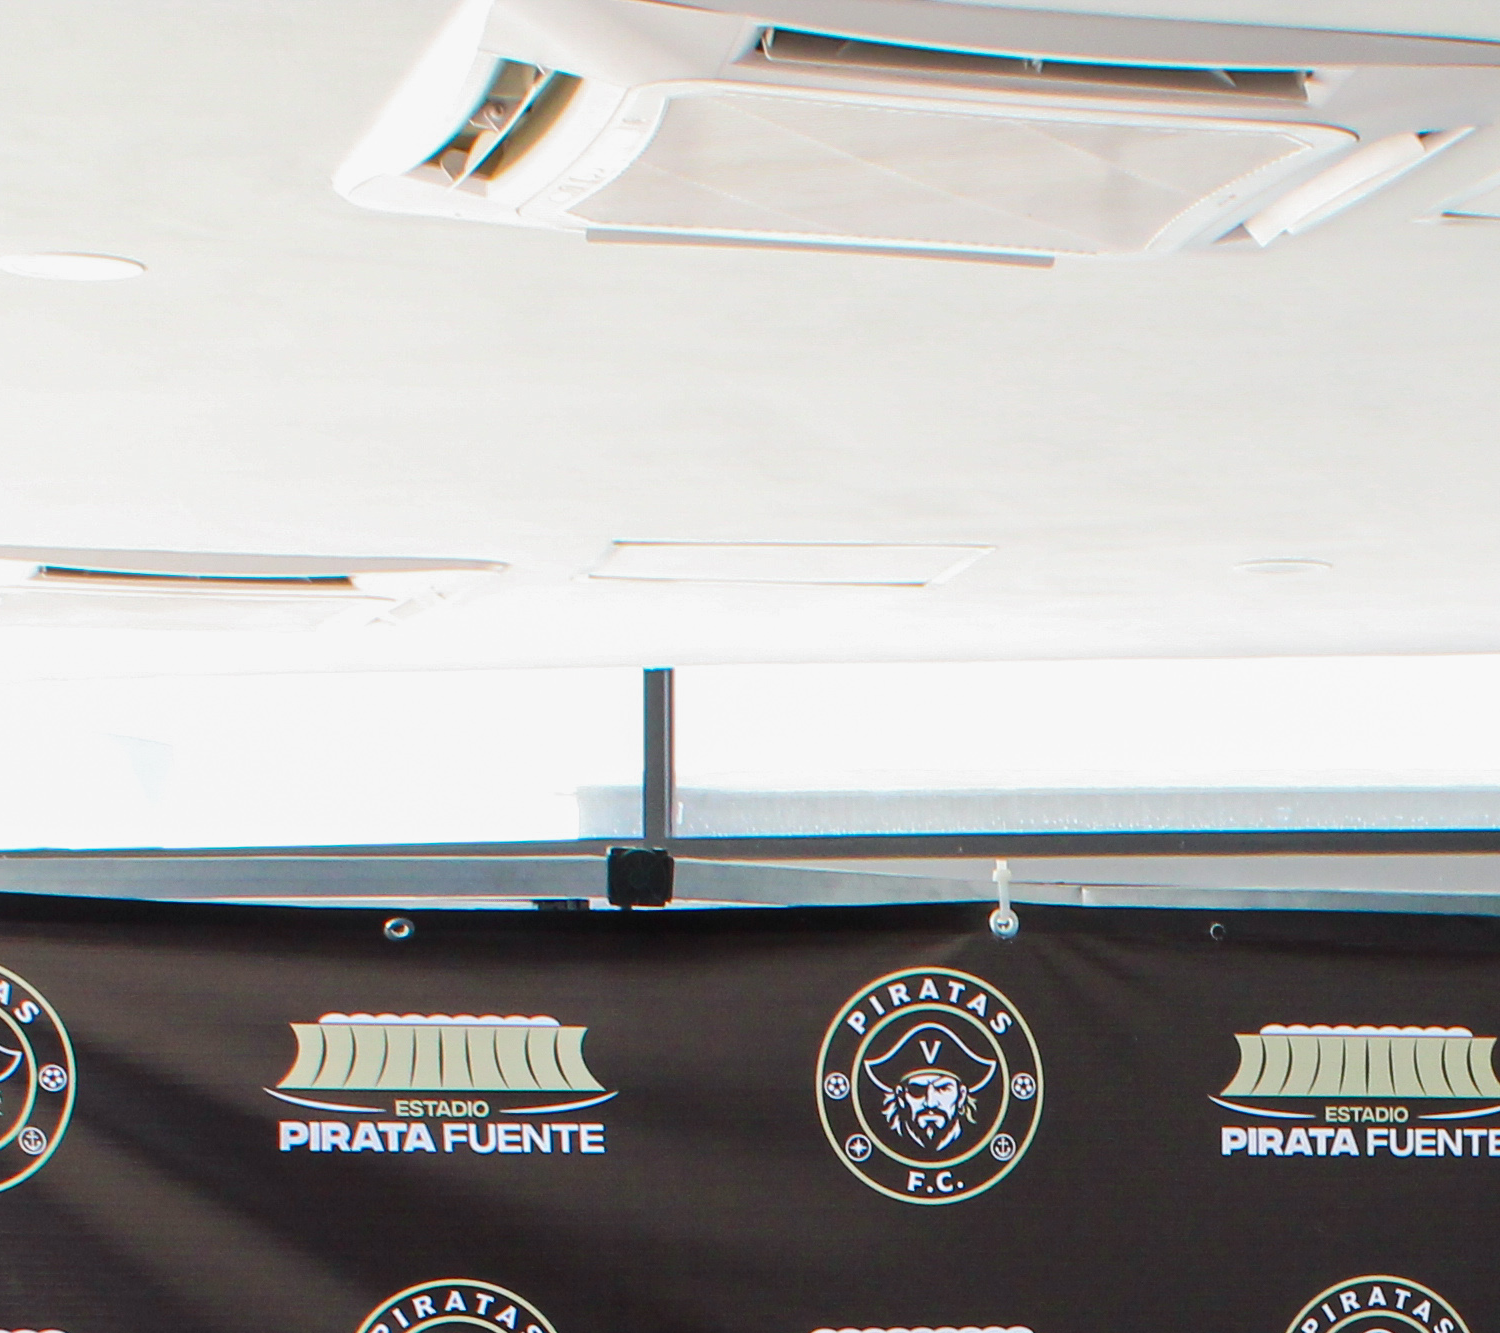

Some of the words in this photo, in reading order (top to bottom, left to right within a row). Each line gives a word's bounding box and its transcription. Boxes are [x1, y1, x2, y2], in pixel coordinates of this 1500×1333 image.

[846, 978, 1012, 1035] PIRATAS
[395, 1100, 490, 1118] ESTADIO
[1325, 1106, 1409, 1123] ESTADIO
[279, 1121, 436, 1152] PIRATA
[442, 1123, 605, 1153] FUENTE
[1221, 1127, 1360, 1156] PIRATA
[907, 1170, 964, 1193] F.C.
